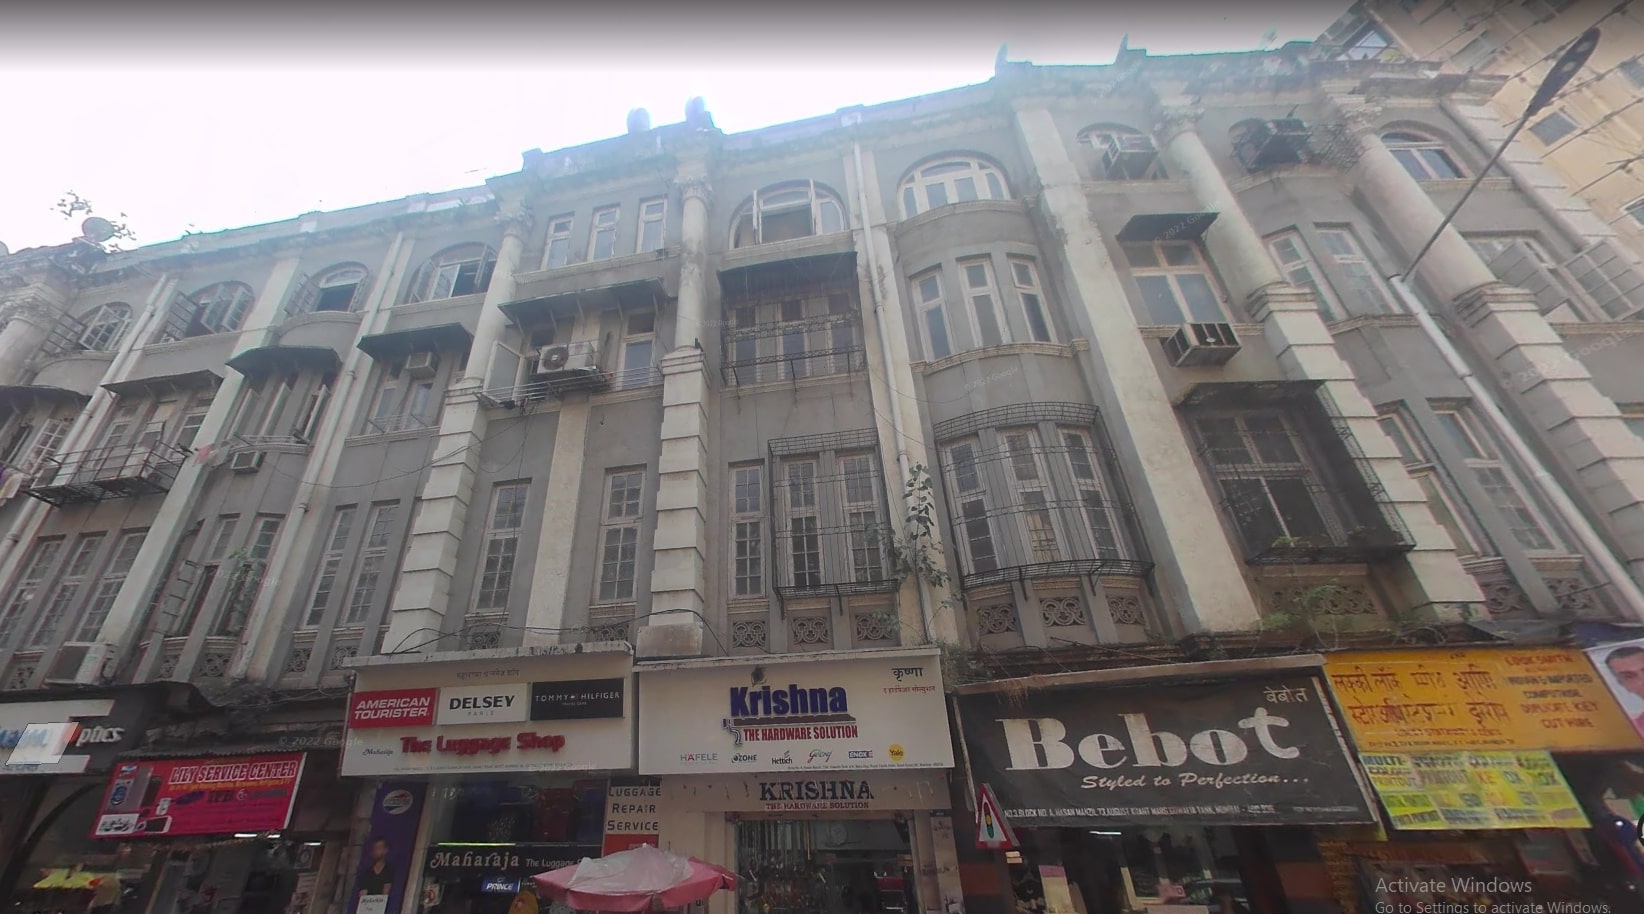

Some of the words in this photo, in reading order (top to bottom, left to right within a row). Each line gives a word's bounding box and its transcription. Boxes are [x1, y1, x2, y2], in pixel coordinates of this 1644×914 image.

[891, 667, 924, 682] कृष्णा
[535, 694, 569, 702] TOMMY
[580, 691, 620, 700] HILFIGER
[730, 684, 848, 717] Krishna
[1263, 685, 1309, 703] बेबोत
[356, 697, 431, 710] AMERICAN
[449, 695, 515, 710] DELSEY
[354, 707, 429, 720] TOURISTER
[744, 728, 761, 742] THE
[761, 727, 814, 741] HARDWARE
[814, 725, 858, 739] SOLUTION
[995, 707, 1299, 771] Bebot
[400, 736, 432, 753] The
[436, 735, 512, 755] Luggage
[517, 732, 566, 752] Shop
[771, 757, 793, 765] Hettich
[889, 749, 904, 757] Yale
[169, 766, 196, 785] LILY
[197, 763, 249, 782] SERVICE
[249, 760, 298, 780] CENTER
[759, 780, 875, 801] KRISHNA
[1081, 775, 1147, 791] Styled
[1153, 775, 1171, 786] to
[608, 786, 662, 797] LUGGAGE
[612, 803, 656, 814] REPAIR
[829, 801, 869, 809] SOLUTION
[607, 820, 659, 831] SERVICE
[429, 850, 520, 871] Maharaja
[526, 858, 540, 867] The
[485, 881, 513, 891] PRINCE
